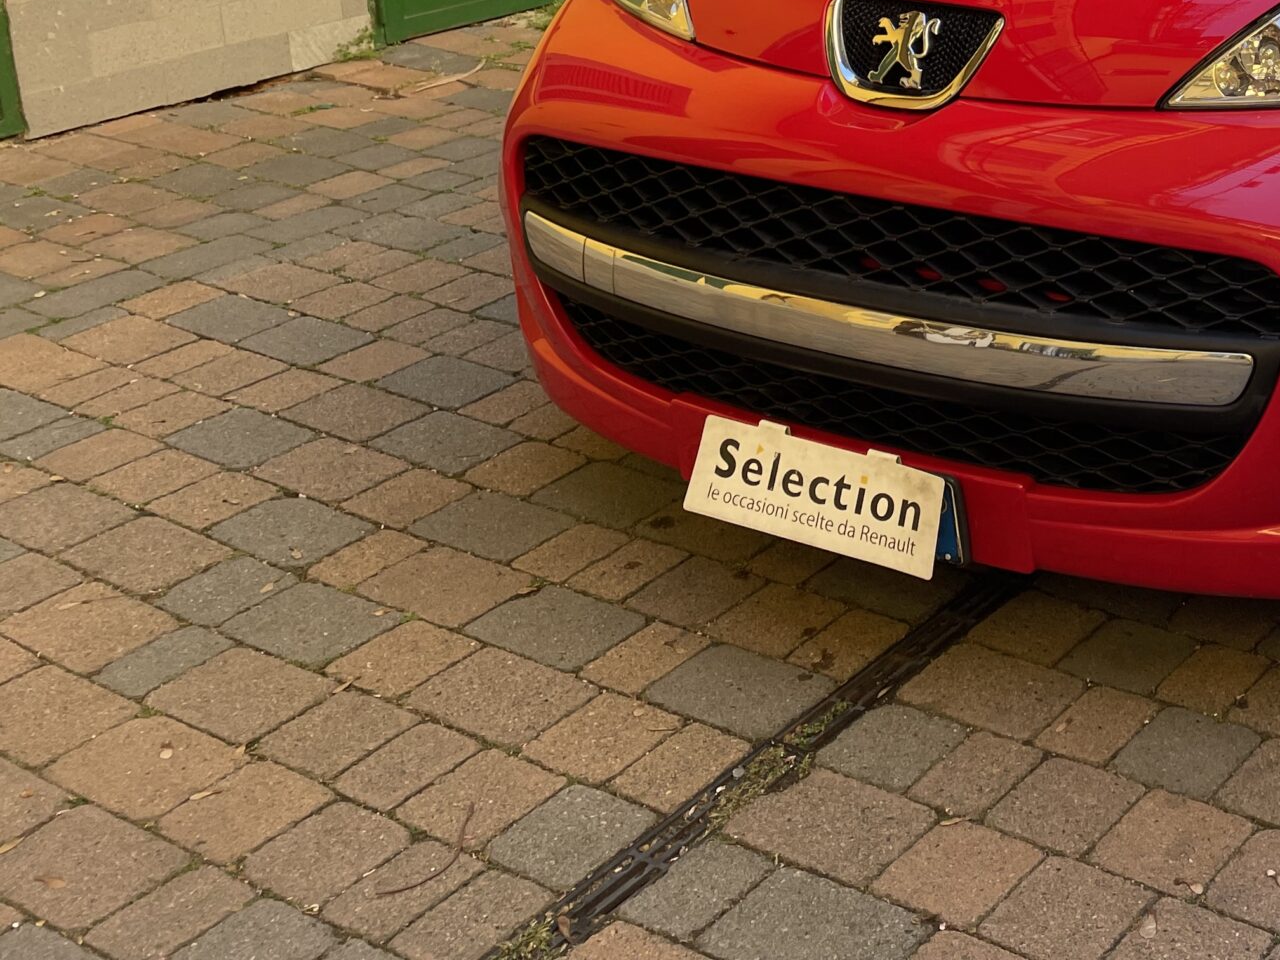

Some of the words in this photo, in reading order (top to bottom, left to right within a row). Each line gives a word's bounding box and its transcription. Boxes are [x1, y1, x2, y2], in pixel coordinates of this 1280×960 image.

[707, 482, 720, 500] le
[723, 489, 790, 520] occasioni
[791, 511, 834, 532] scelte
[837, 520, 856, 538] da
[859, 525, 916, 556] Renault
